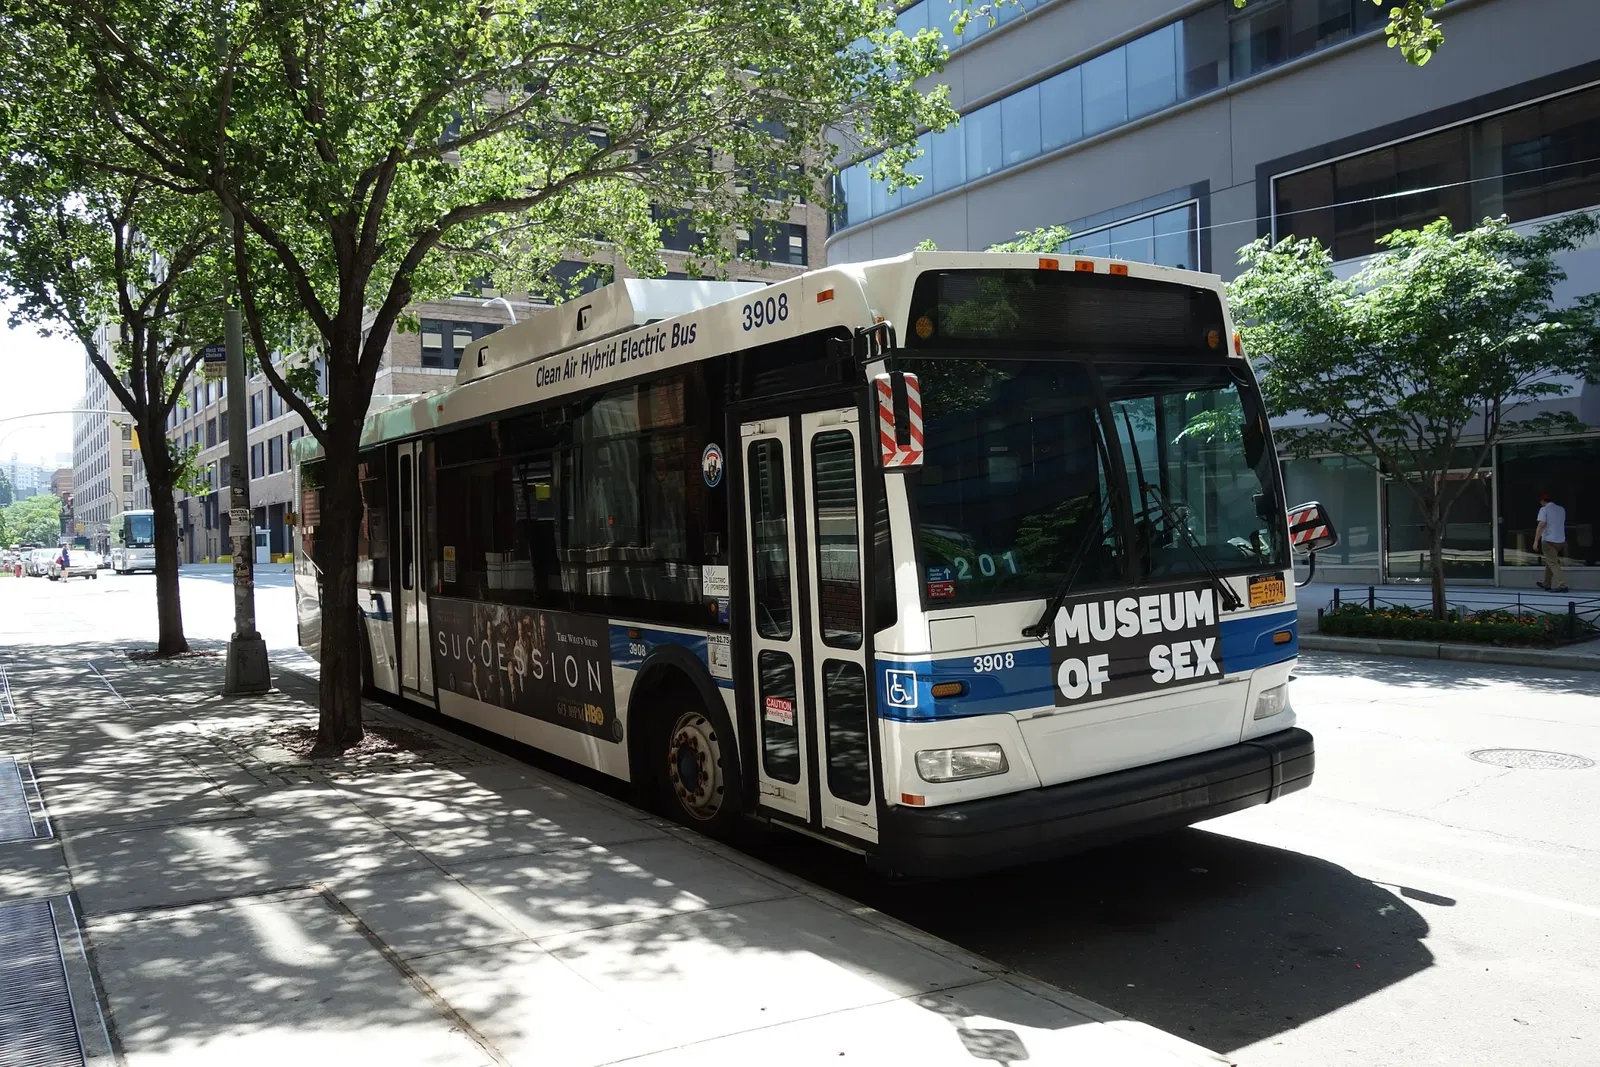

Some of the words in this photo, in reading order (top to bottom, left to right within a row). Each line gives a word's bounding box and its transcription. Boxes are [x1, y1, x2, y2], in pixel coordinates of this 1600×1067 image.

[742, 292, 789, 332] 3908
[536, 363, 561, 388] Clean
[563, 358, 578, 380] Air
[581, 342, 617, 379] Hybrid
[620, 327, 667, 364] Electric
[671, 322, 697, 349] Bus
[953, 550, 1017, 580] 201
[711, 583, 729, 591] POWERED
[1054, 588, 1216, 647] MUSEUM
[628, 642, 646, 657] 3908
[716, 635, 730, 644] $2.75
[438, 630, 602, 694] SUCCESSION
[973, 652, 1015, 673] 3908
[1057, 653, 1111, 700] OF
[1148, 637, 1220, 684] SEX
[584, 703, 604, 726] HBO
[766, 697, 792, 711] CAUTION
[766, 708, 784, 719] Kneeling
